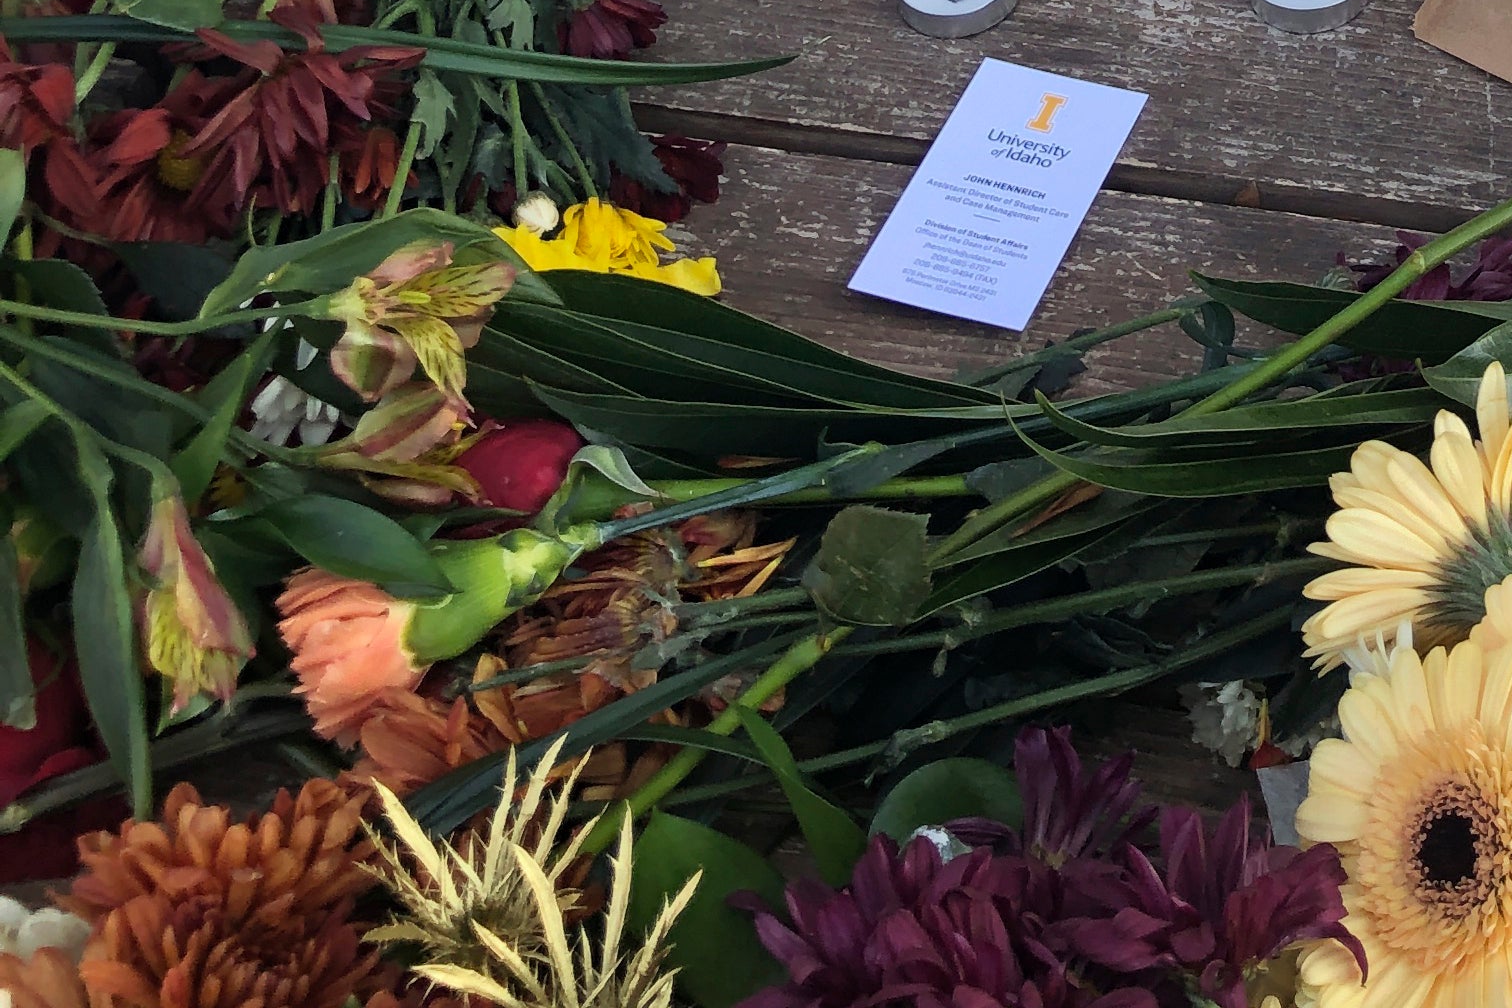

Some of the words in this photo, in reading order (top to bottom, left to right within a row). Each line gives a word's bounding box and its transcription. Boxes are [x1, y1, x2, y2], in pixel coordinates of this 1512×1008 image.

[987, 128, 1071, 161] University
[990, 148, 1008, 158] of
[1005, 147, 1052, 168] Idaho
[926, 178, 967, 194] Assistant
[967, 188, 1003, 203] Director
[1013, 200, 1048, 214] Student
[1048, 208, 1069, 219] Care
[963, 174, 993, 186] JOHN
[993, 181, 1046, 200] HENNRICH
[944, 195, 963, 203] and
[962, 197, 984, 209] Case
[984, 203, 1040, 223] Management
[915, 227, 939, 238] Office
[948, 236, 962, 244] the
[962, 238, 983, 249] Dean
[992, 246, 1028, 260] Students
[924, 219, 957, 233] Division
[967, 230, 1000, 243] Student
[1000, 239, 1028, 250] Affairs
